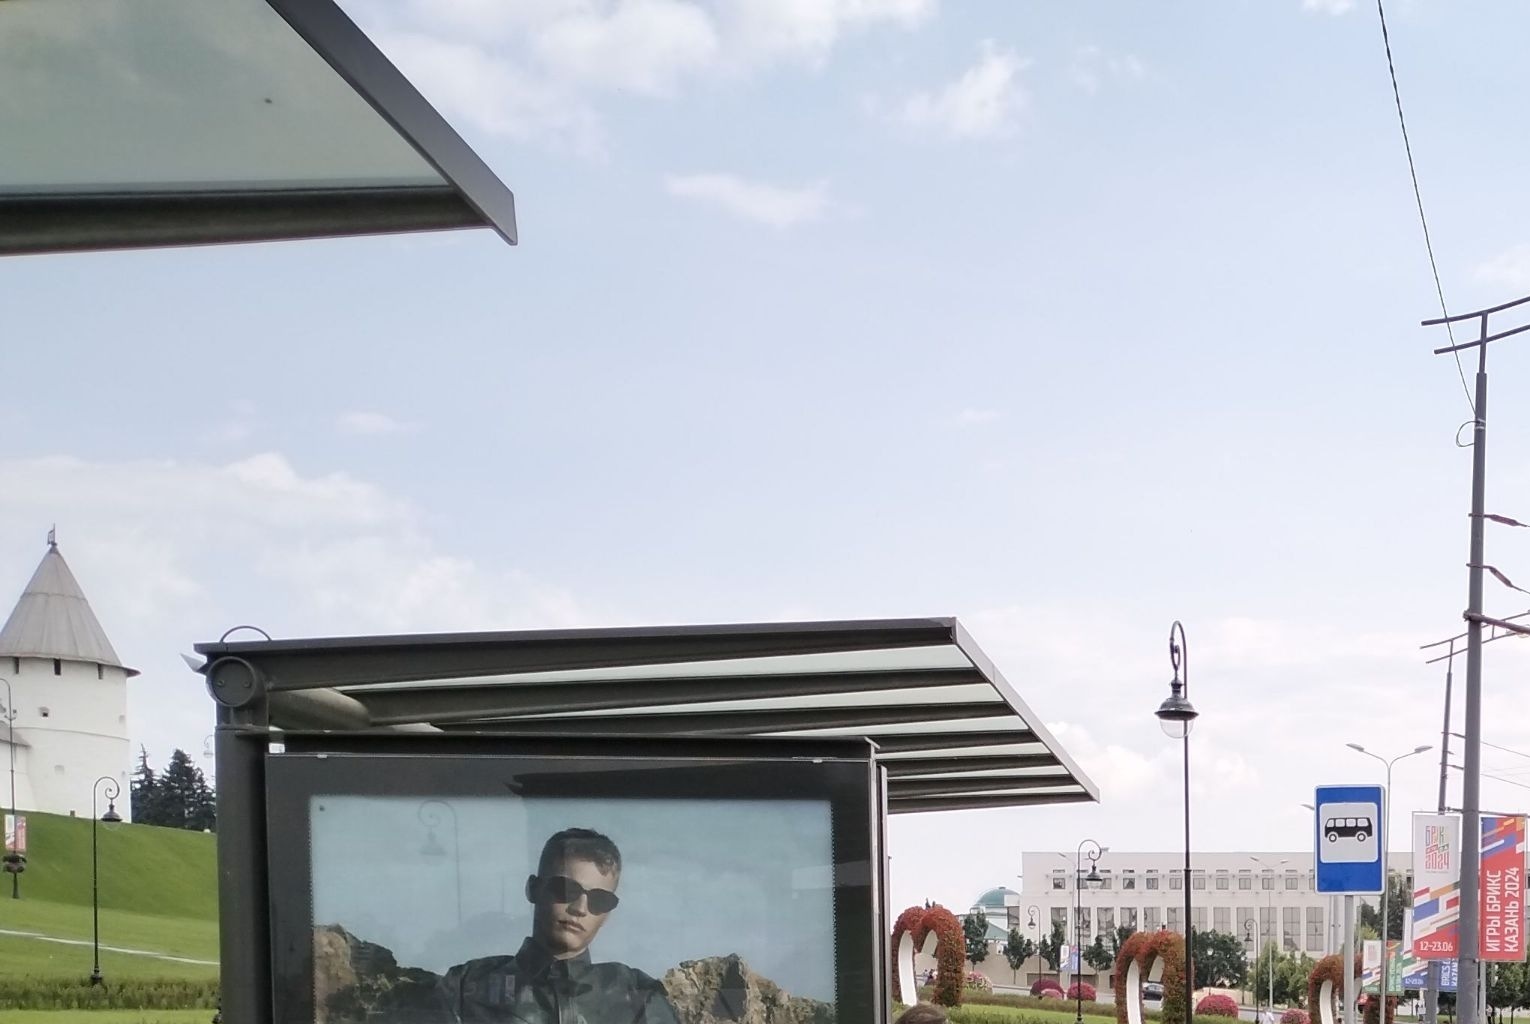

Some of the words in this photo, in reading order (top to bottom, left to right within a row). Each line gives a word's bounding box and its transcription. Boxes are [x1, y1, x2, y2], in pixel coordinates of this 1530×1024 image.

[1486, 869, 1502, 912] БРИКС
[1504, 866, 1520, 898] 2024
[1486, 916, 1501, 952] ИГРЫ
[1504, 901, 1520, 953] КАЗАНЬ
